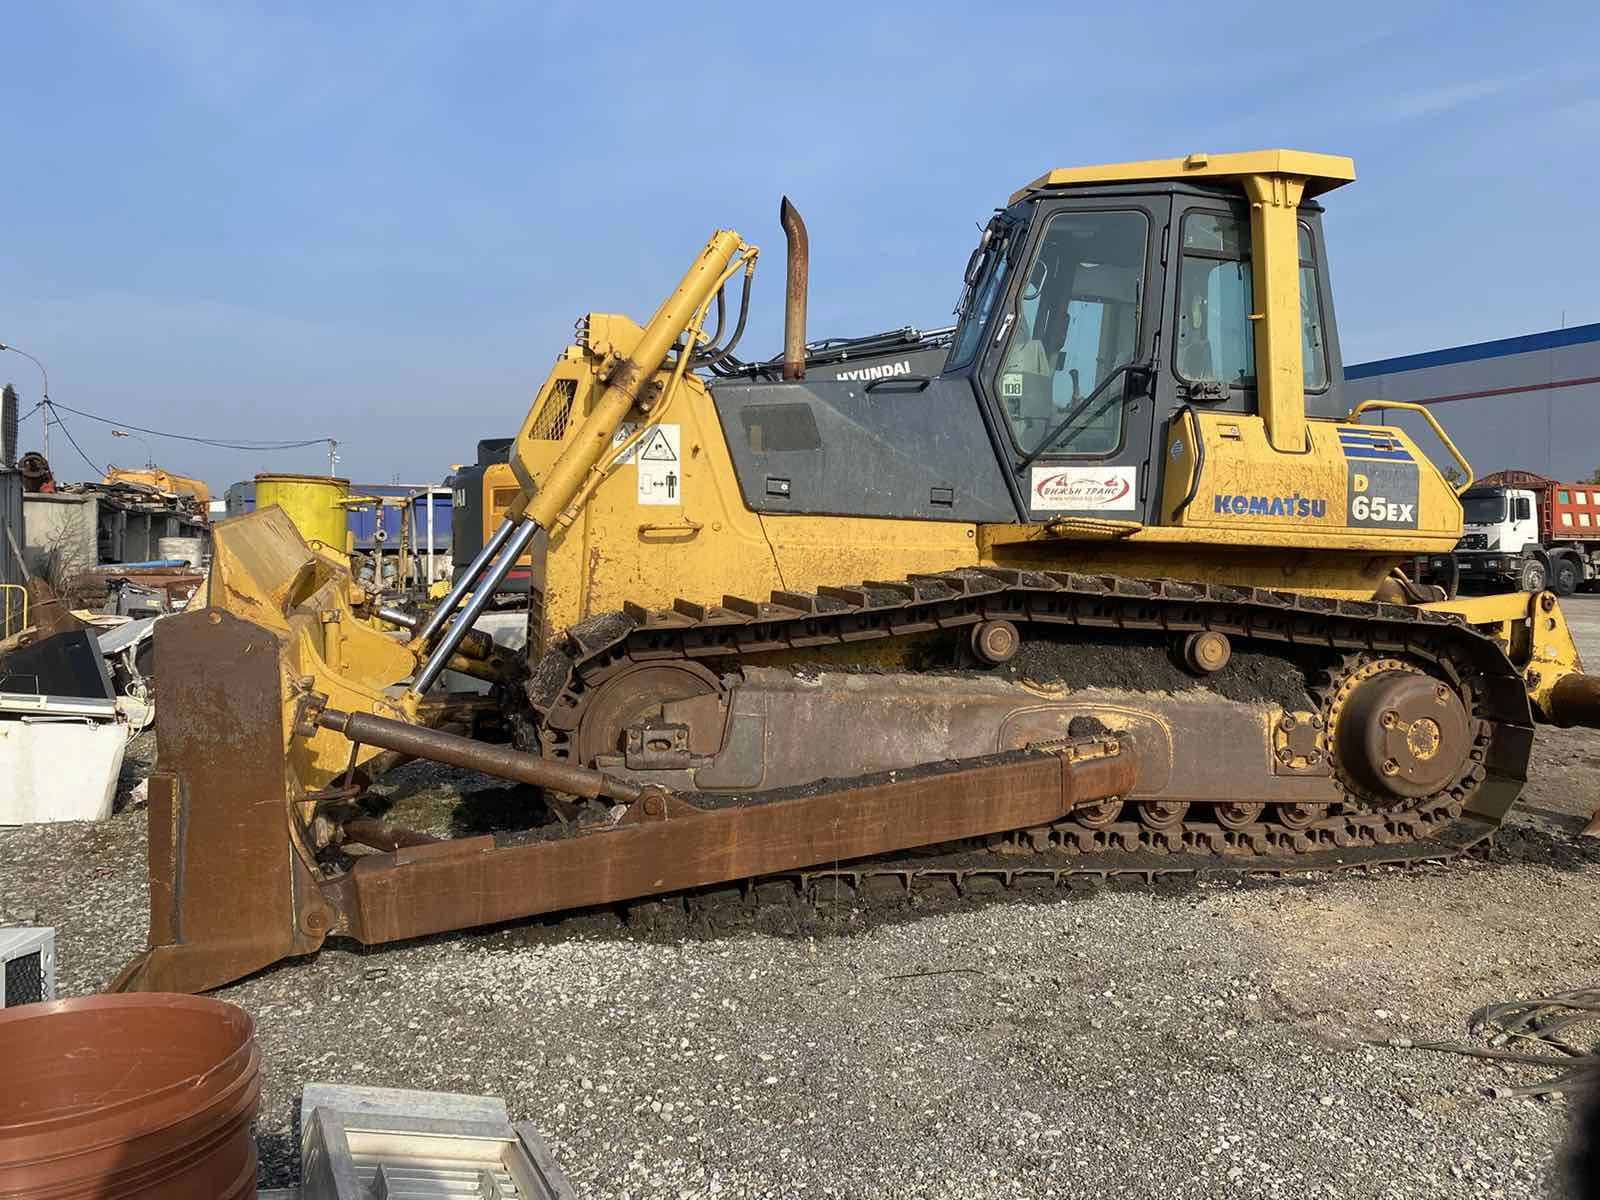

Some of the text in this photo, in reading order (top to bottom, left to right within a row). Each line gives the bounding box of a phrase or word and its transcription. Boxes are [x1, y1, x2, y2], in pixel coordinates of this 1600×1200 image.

[836, 361, 911, 381] HYUNDAI
[1086, 487, 1118, 495] ТРАНС
[1353, 473, 1369, 492] D
[1214, 491, 1326, 518] KOMATSU
[1352, 495, 1414, 522] 65EX
